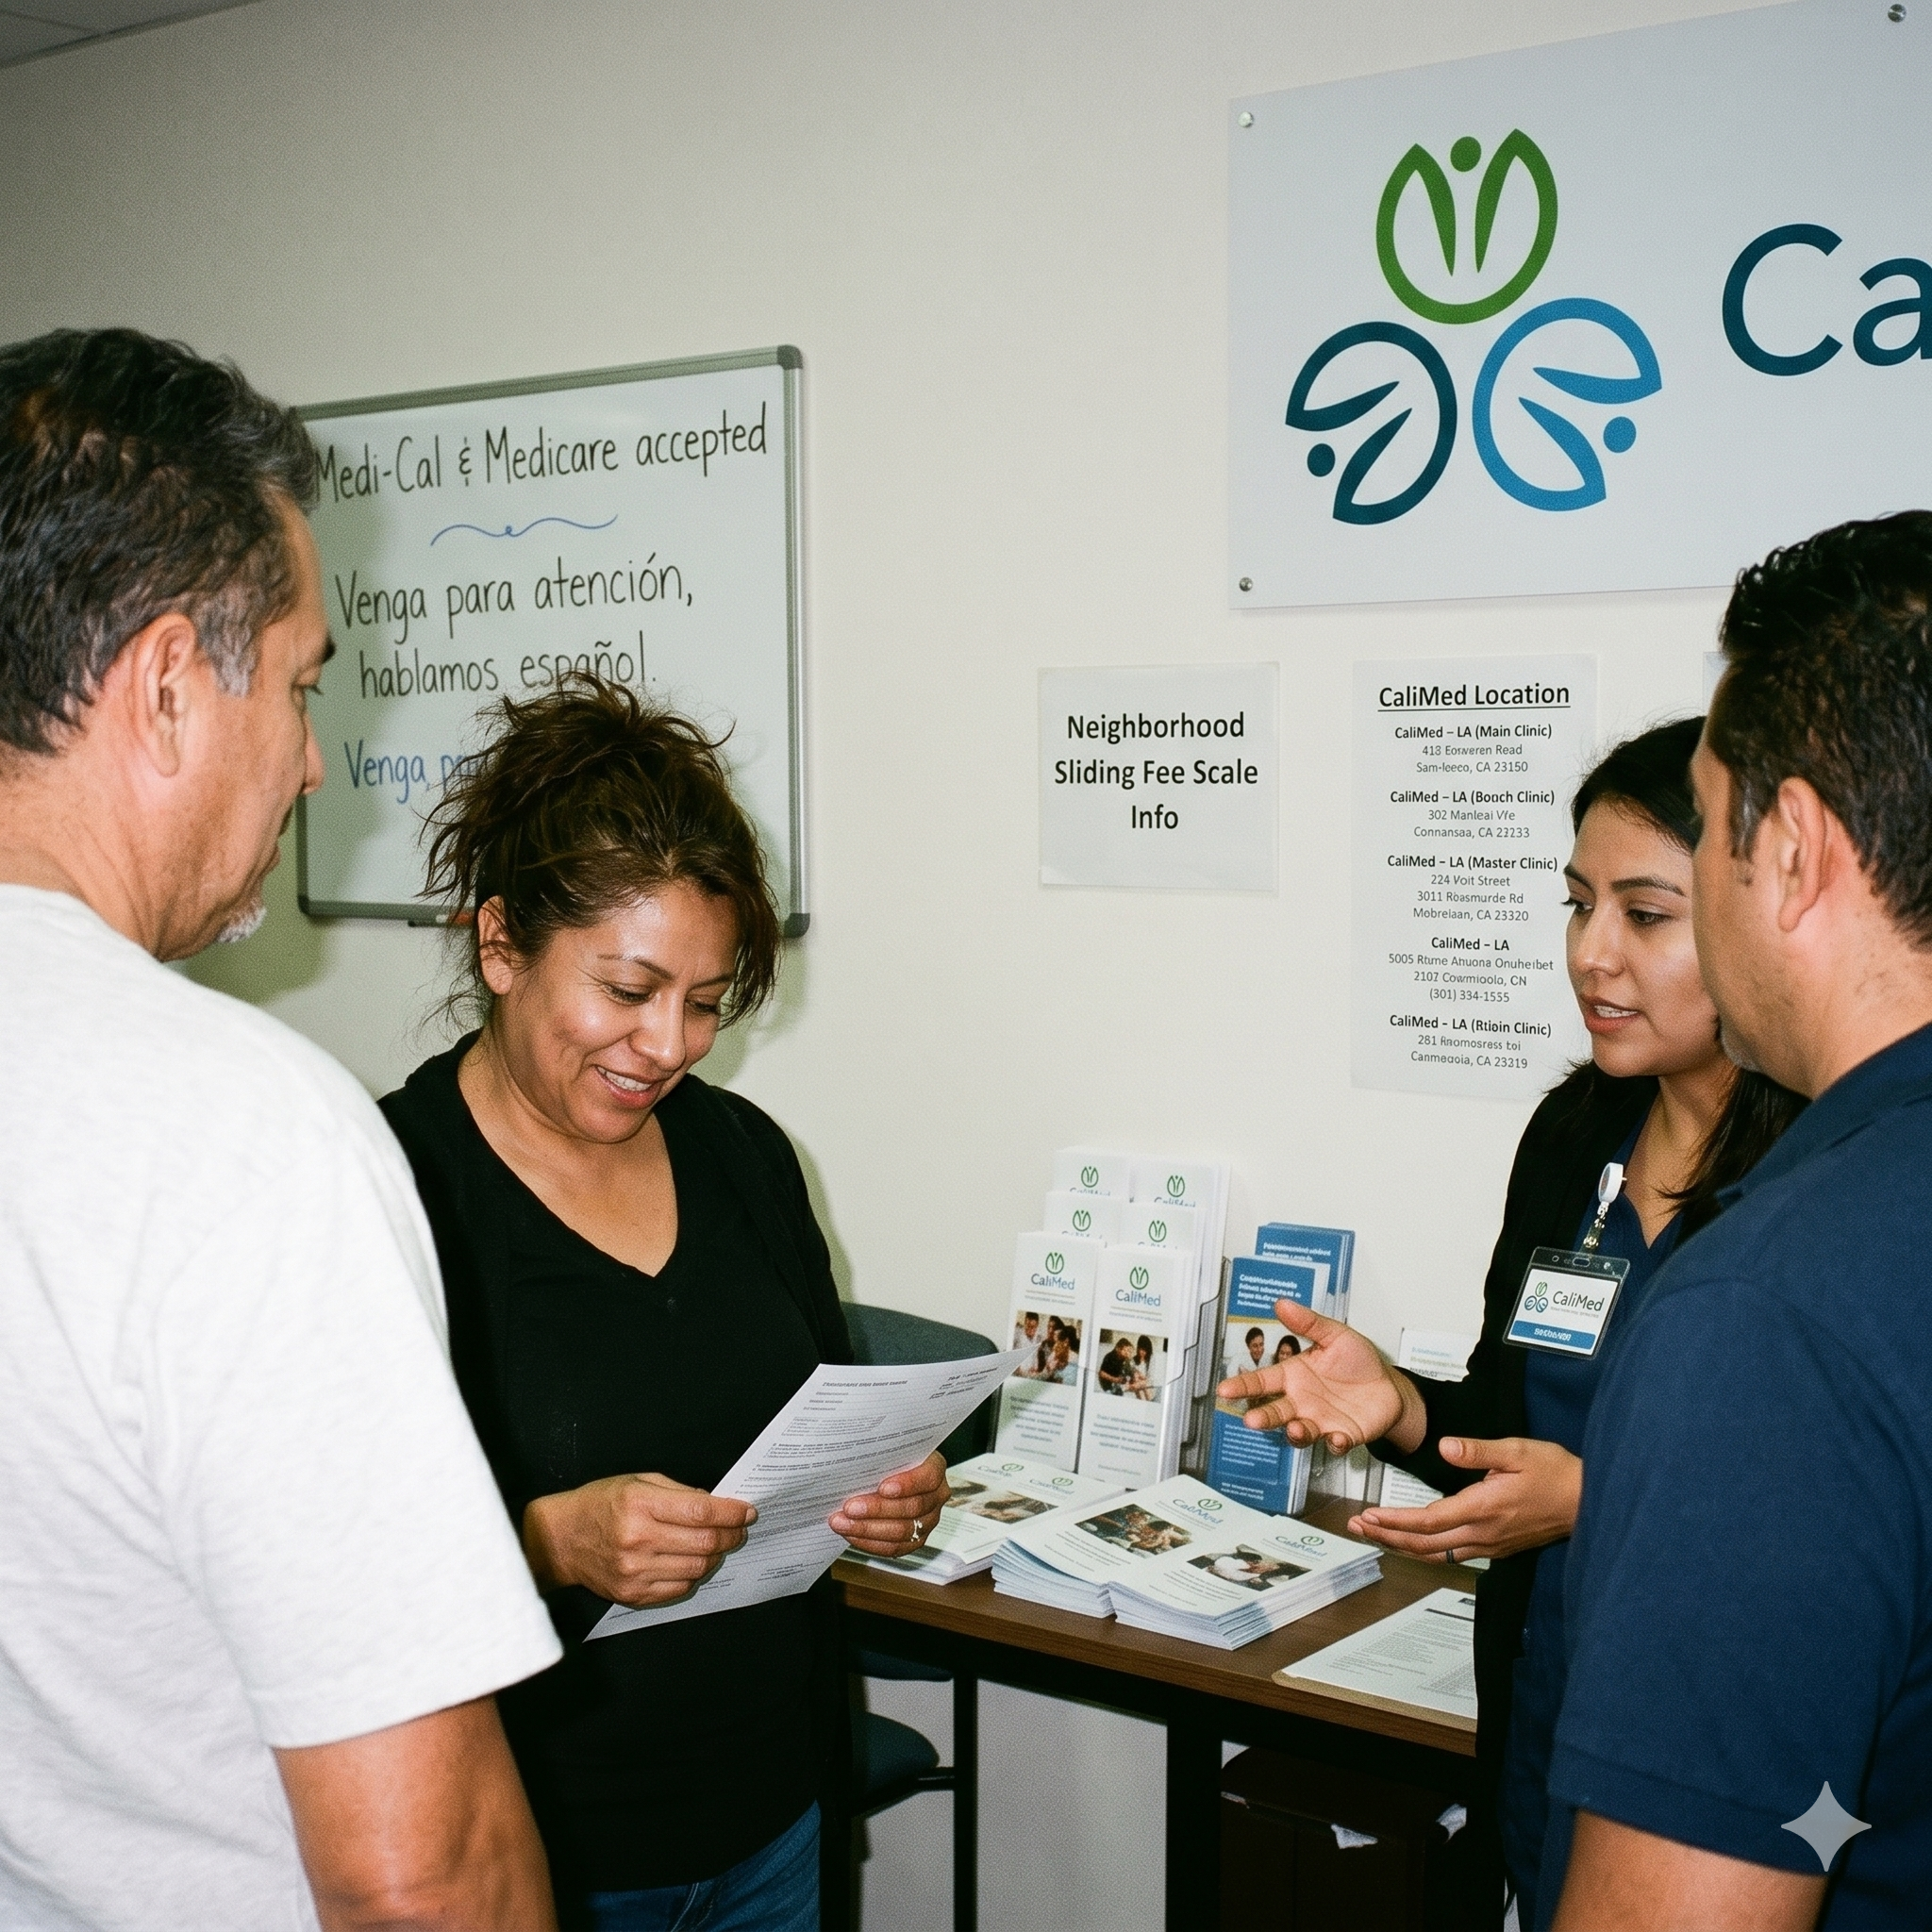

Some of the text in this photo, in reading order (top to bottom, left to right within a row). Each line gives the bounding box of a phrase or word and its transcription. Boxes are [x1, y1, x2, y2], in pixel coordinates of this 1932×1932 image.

[313, 435, 441, 503] Medi-Cal
[485, 425, 620, 484] Medicare
[635, 400, 767, 477] accepted
[335, 552, 692, 645] Venga para atención,
[359, 630, 656, 699] hablamos español.
[1379, 683, 1570, 708] CaliMed Location
[1068, 711, 1244, 744] Neighborhood
[1394, 725, 1443, 740] CaliMed
[1457, 725, 1473, 738] LA
[1474, 724, 1511, 741] (Main
[1514, 723, 1553, 740] Clinic)
[1495, 743, 1523, 756] Read
[1055, 758, 1257, 790] Sliding Fee Scale
[1475, 761, 1491, 773] CA
[1493, 760, 1529, 773] 23150
[1390, 790, 1439, 803] CaliMed
[1452, 791, 1468, 803] LA
[1516, 790, 1555, 807] Clinic)
[1132, 804, 1178, 829] Info
[1427, 809, 1448, 821] 302
[1477, 826, 1493, 838] CA
[1387, 855, 1436, 868] CaliMed
[1449, 856, 1465, 868] LA
[1468, 855, 1517, 871] (Master
[1519, 857, 1558, 873] Clinic)
[1430, 874, 1451, 885] 224
[1477, 874, 1511, 887] Street
[1417, 890, 1443, 902] 3011
[1508, 892, 1524, 905] Rd
[1476, 908, 1492, 921] CA
[1494, 909, 1529, 922] 23320
[1431, 936, 1480, 951] CaliMed
[1494, 939, 1510, 951] LA
[1389, 953, 1414, 965] 5005
[1509, 974, 1527, 987] CN
[1429, 988, 1510, 1003] (301) 334-1555
[1390, 1014, 1439, 1029] CaliMed
[1452, 1018, 1468, 1030] LA
[1513, 1022, 1552, 1039] Clinic)
[1417, 1034, 1438, 1046] 281
[1475, 1055, 1491, 1067] CA
[1031, 1273, 1075, 1291] CaliMed
[1115, 1289, 1161, 1307] CaliMed
[1553, 1291, 1605, 1311] CaliMed
